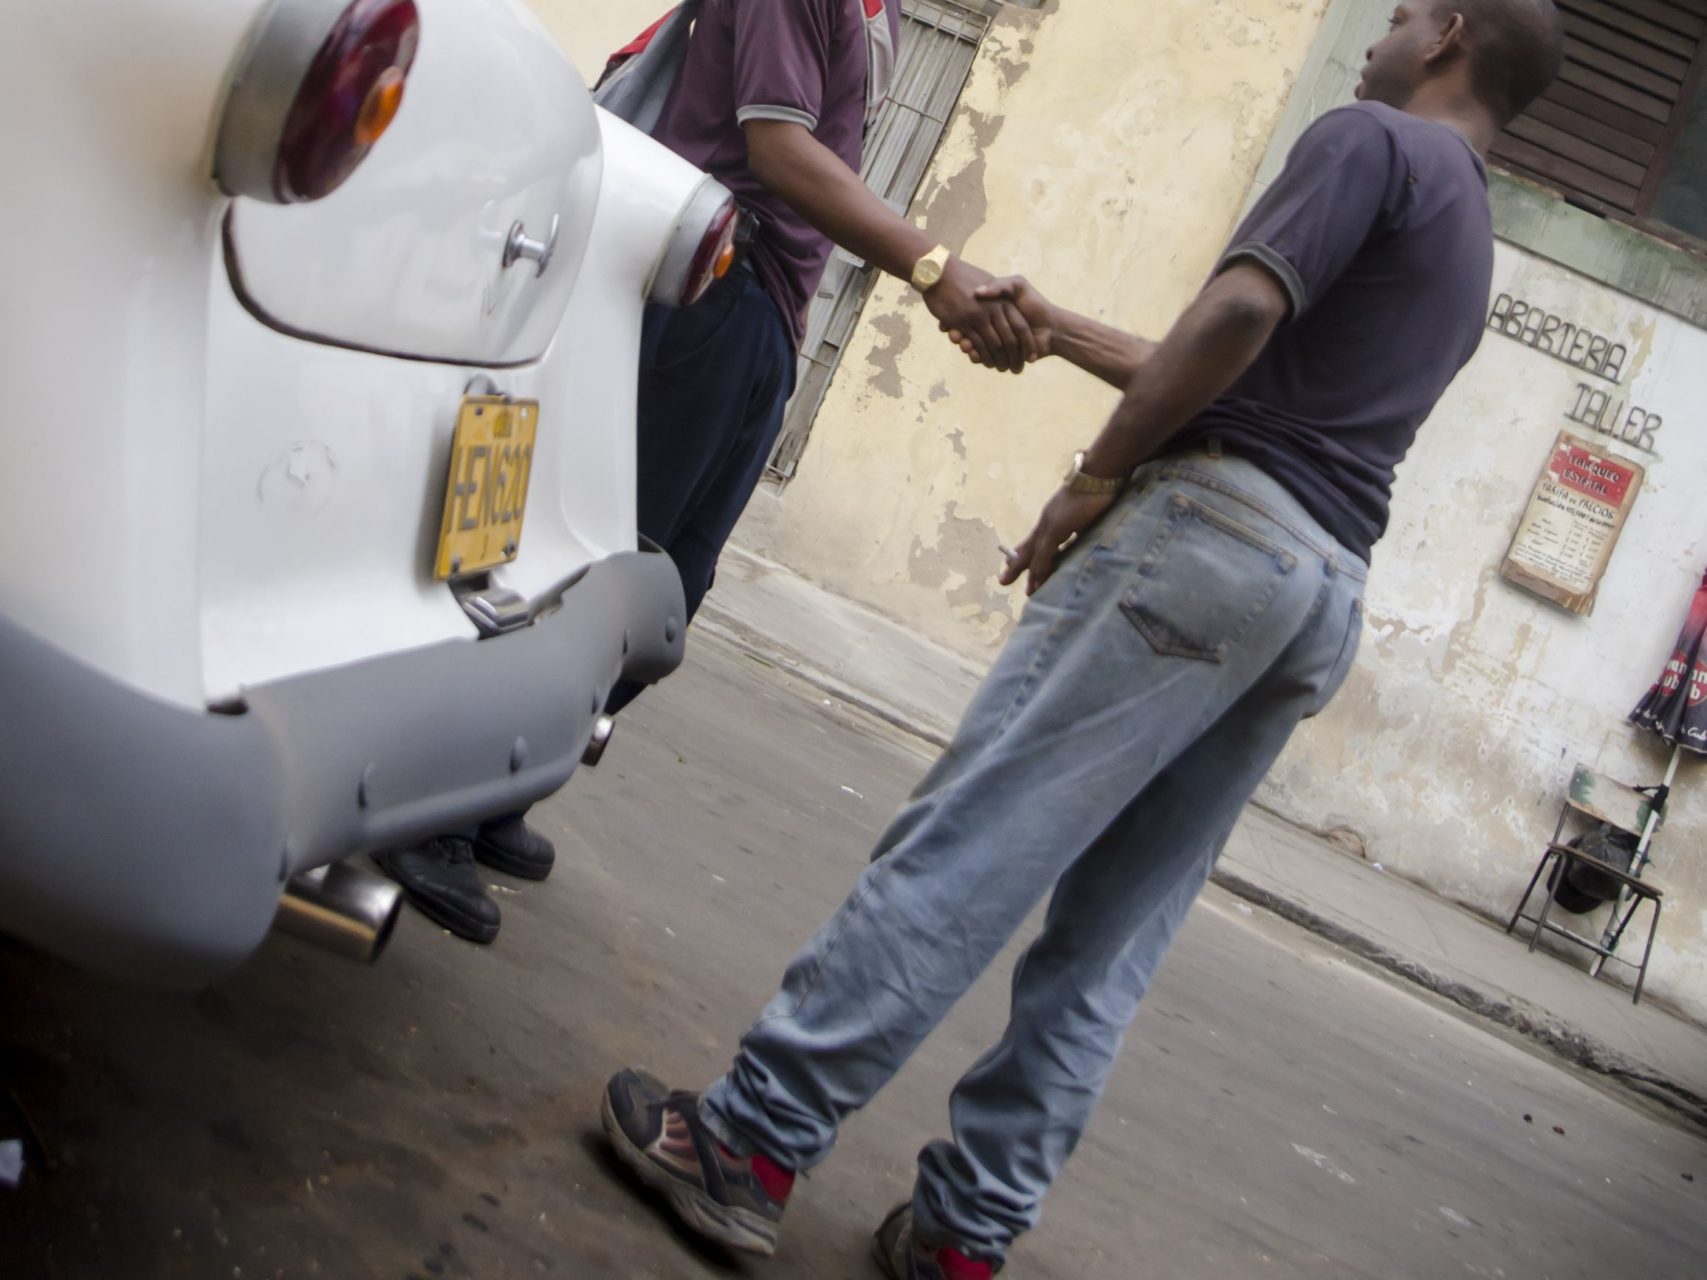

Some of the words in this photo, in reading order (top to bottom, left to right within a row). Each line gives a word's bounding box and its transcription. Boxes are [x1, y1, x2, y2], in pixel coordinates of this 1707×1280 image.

[1571, 382, 1663, 451] TALLER
[1563, 468, 1608, 495] ESTATAL
[1569, 455, 1621, 482] PARQUEO
